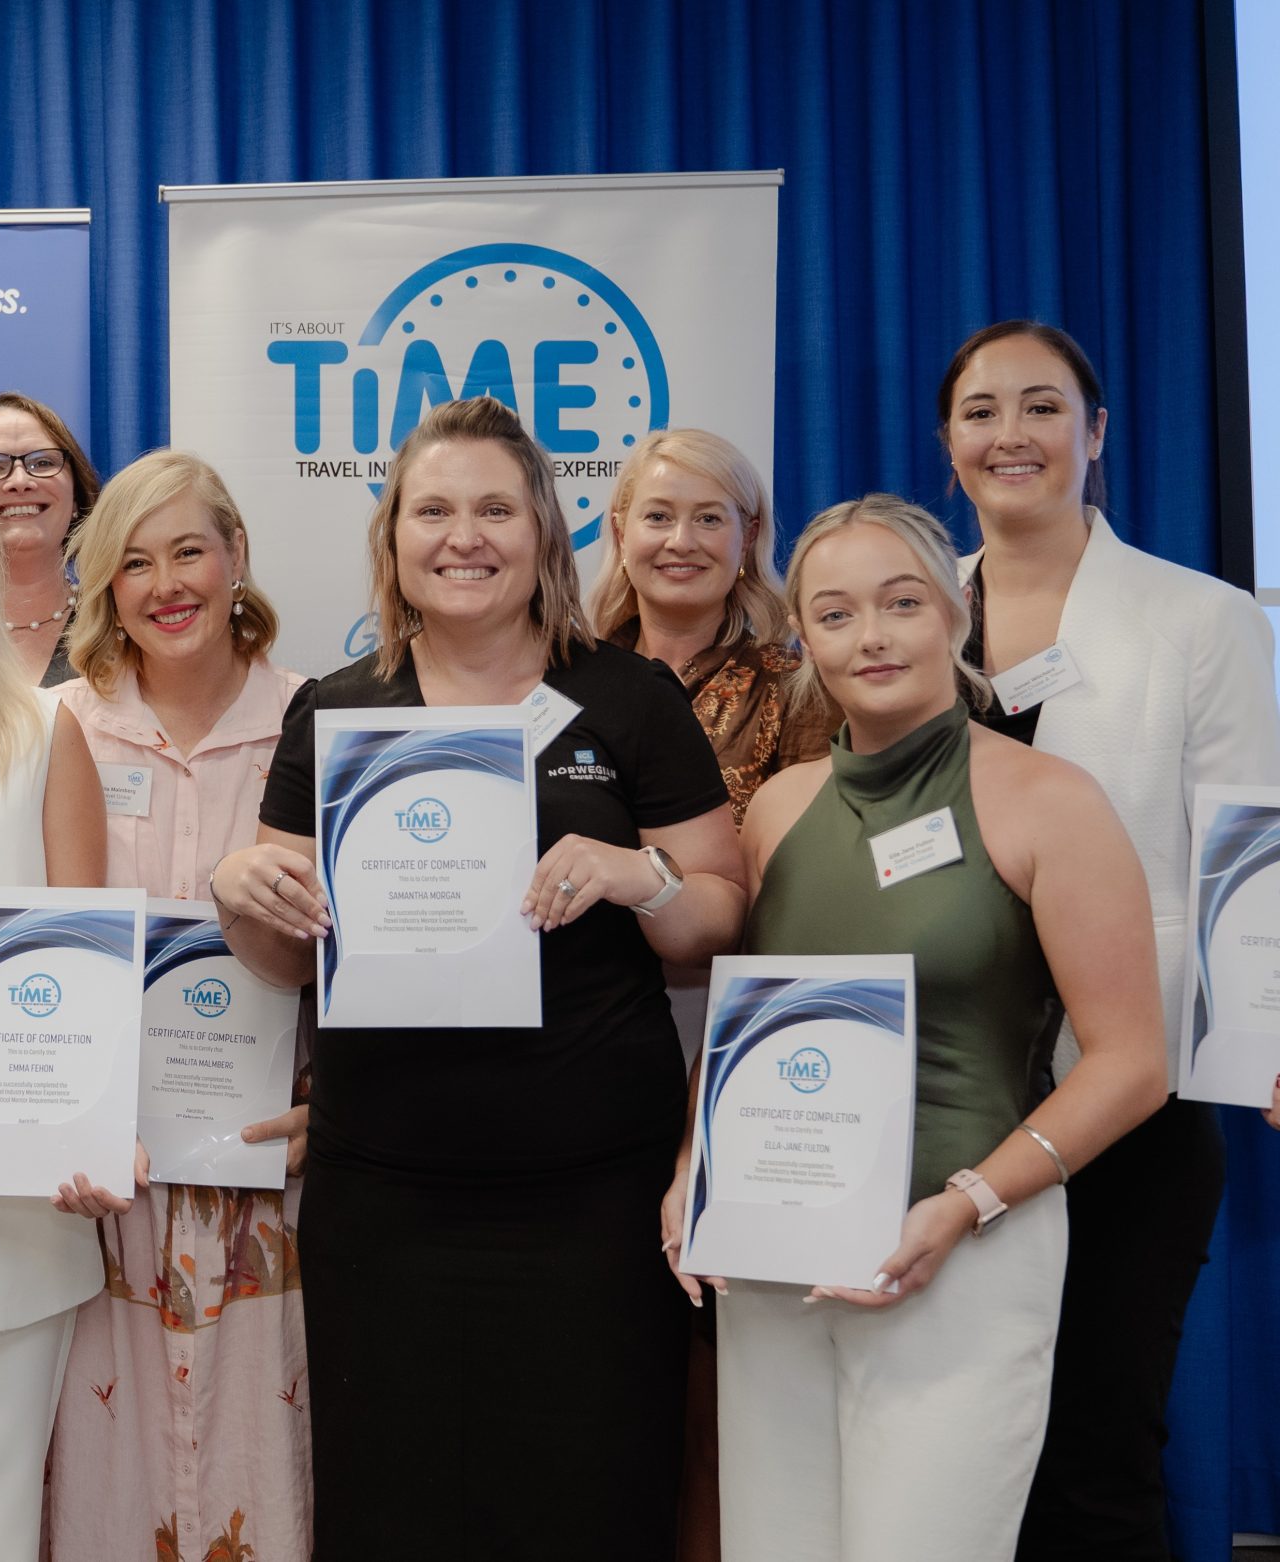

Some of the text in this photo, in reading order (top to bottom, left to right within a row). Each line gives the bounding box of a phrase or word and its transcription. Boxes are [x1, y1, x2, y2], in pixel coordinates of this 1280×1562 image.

[270, 322, 345, 335] IT'S ABOUT
[296, 461, 362, 478] TRAVEL
[548, 766, 616, 779] NORWEGIAN
[394, 812, 440, 828] TiME
[362, 860, 486, 870] CERTIFICATE OF COMPLETION
[389, 891, 460, 900] SAMANTHA MORGAN
[8, 988, 52, 1002] TiME
[182, 990, 222, 1004] TiME
[27, 1033, 37, 1043] OF
[39, 1034, 92, 1044] COMPLETION
[148, 1028, 256, 1044] CERTIFICATE OF COMPLETION
[8, 1064, 54, 1072] EMMA FEHON
[166, 1056, 234, 1069] EMMALITA MALMBERG
[777, 1061, 820, 1078] TiME
[740, 1107, 860, 1123] CERTIFICATE OF COMPLETION
